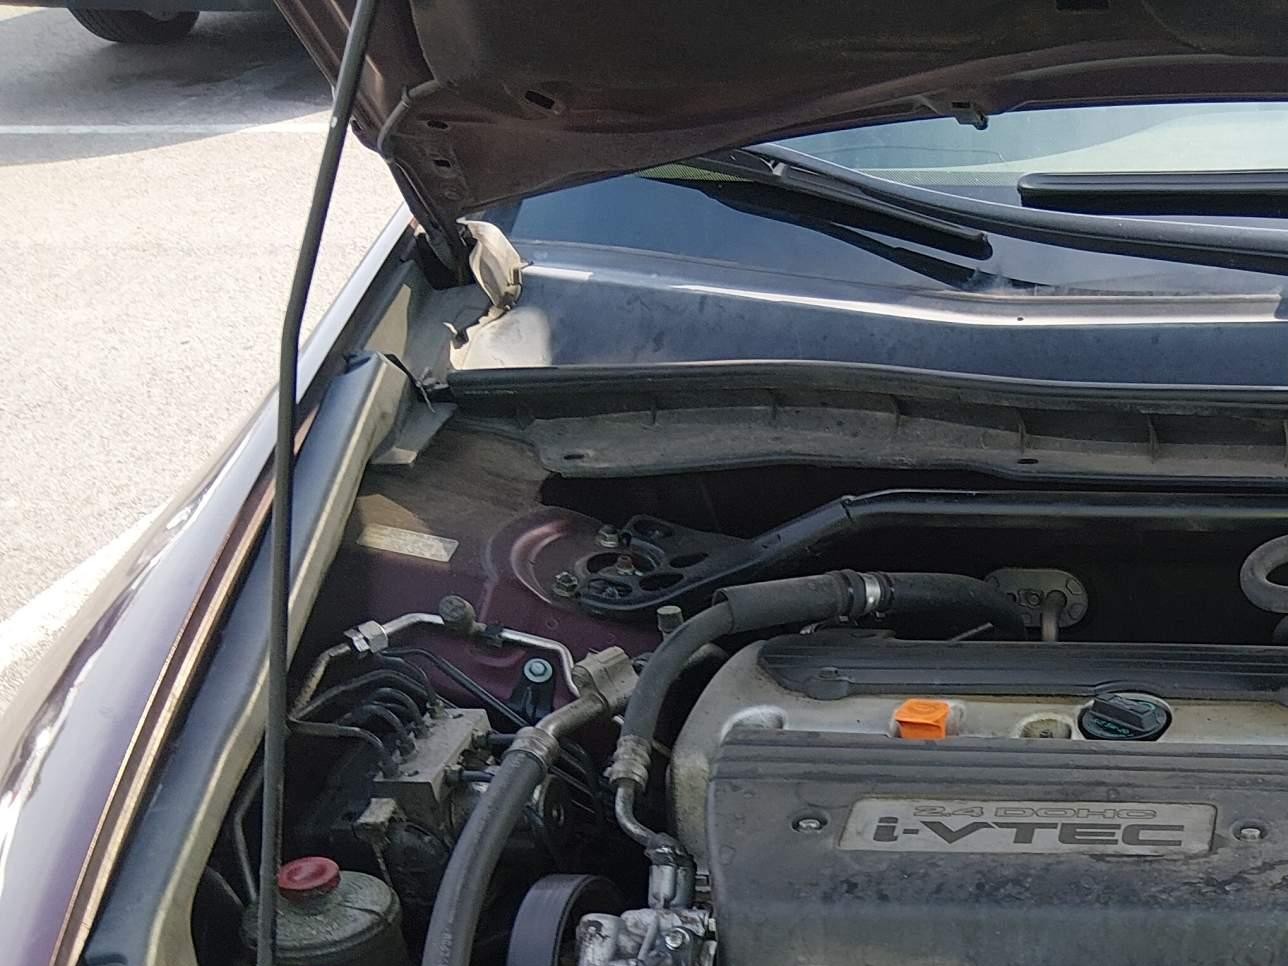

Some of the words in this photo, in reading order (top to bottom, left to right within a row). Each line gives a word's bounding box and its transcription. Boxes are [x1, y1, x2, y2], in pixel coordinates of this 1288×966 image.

[912, 805, 985, 818] 2.4
[993, 806, 1158, 820] DOHC
[873, 816, 1185, 847] i-VTEC
